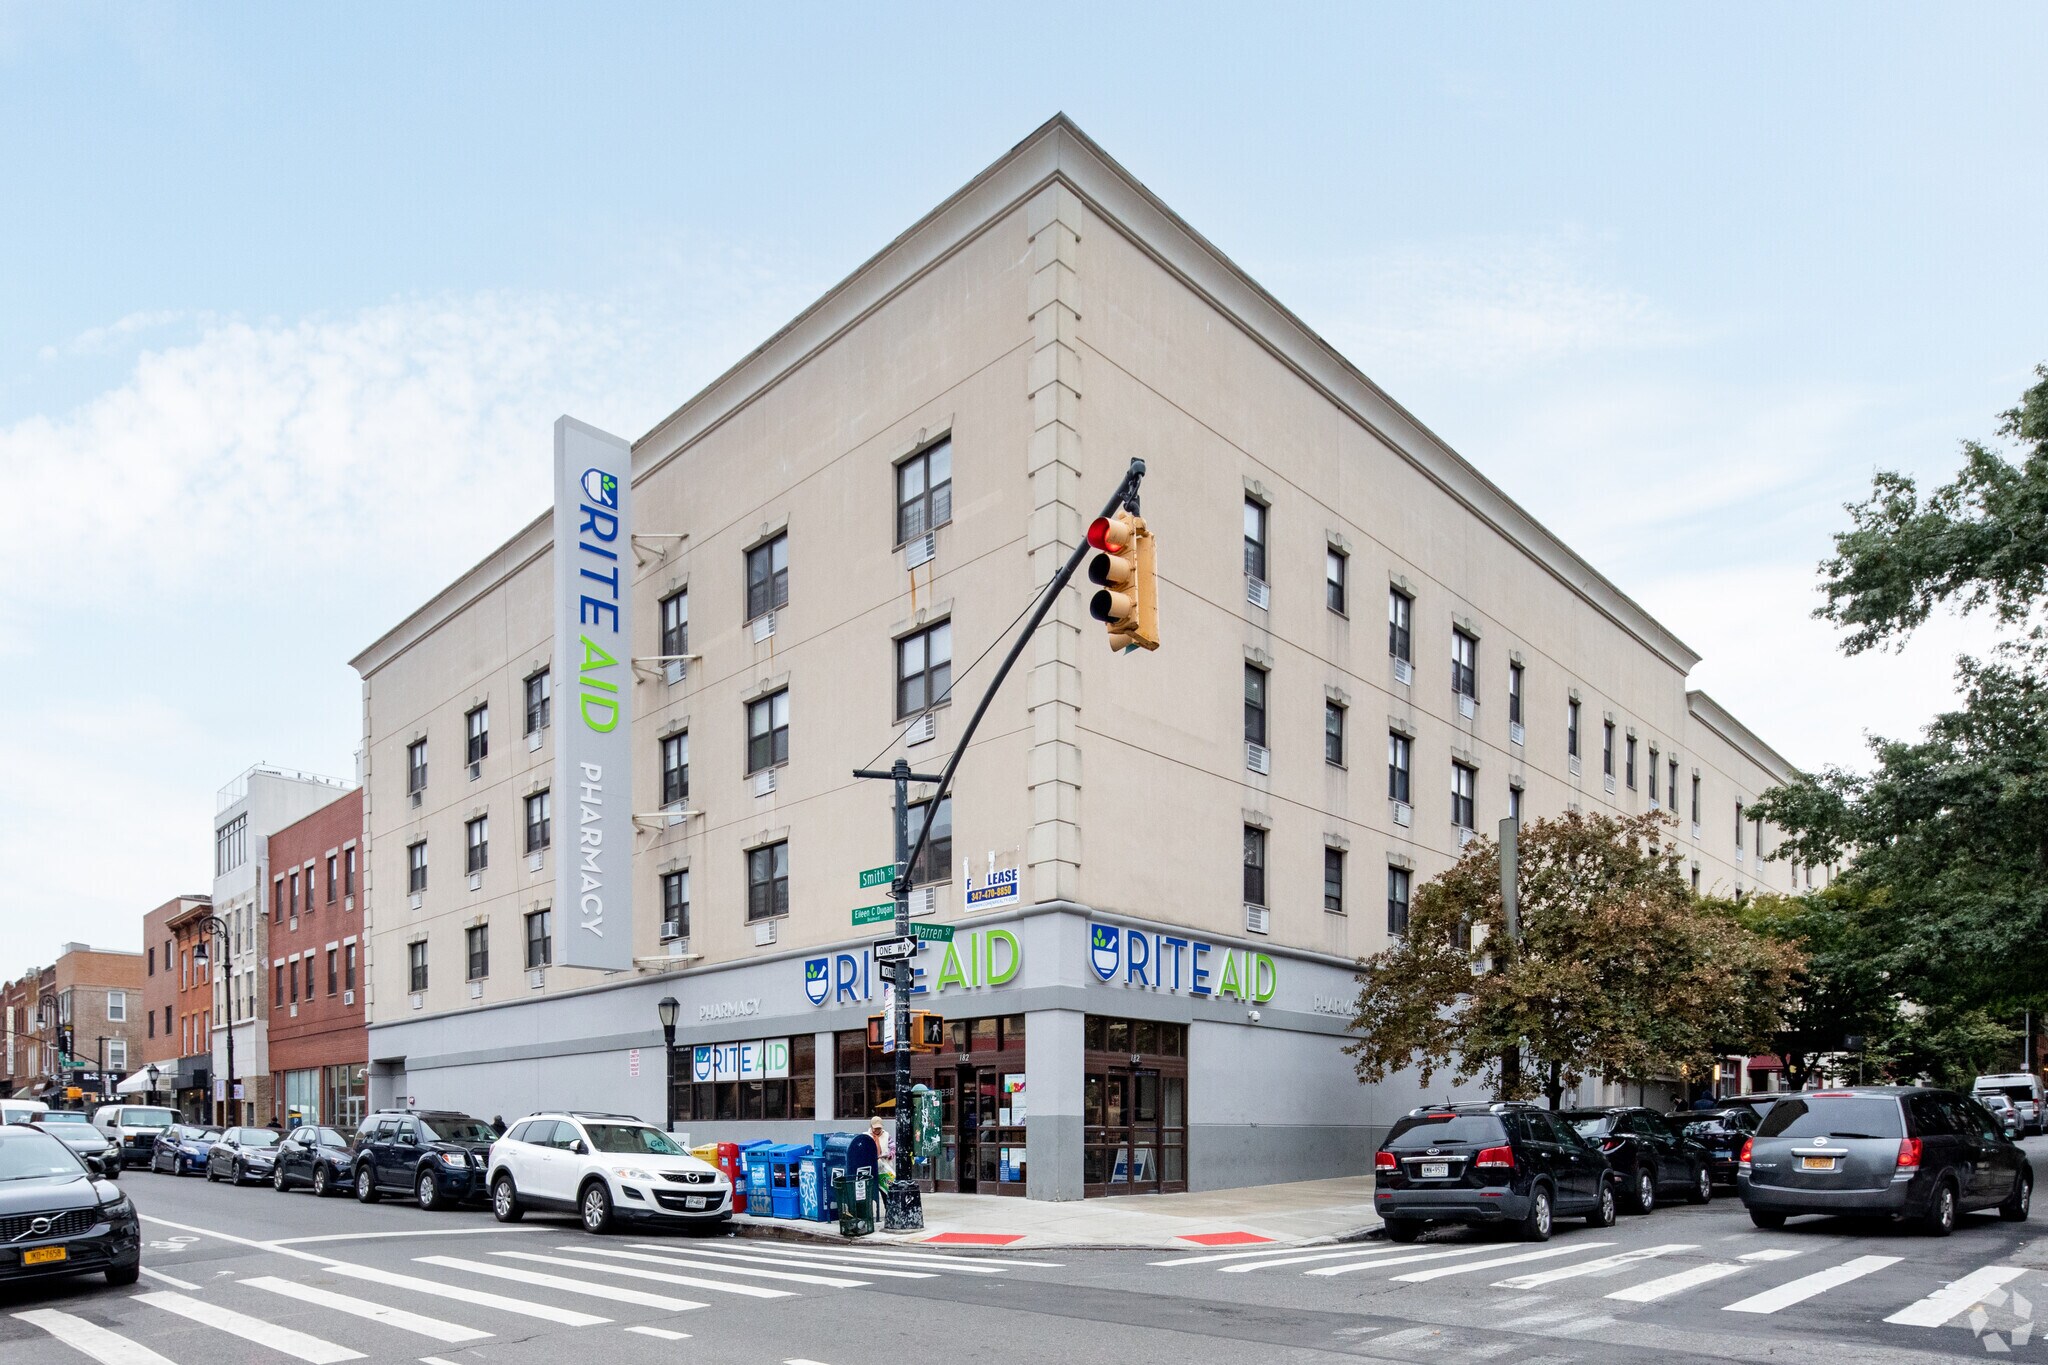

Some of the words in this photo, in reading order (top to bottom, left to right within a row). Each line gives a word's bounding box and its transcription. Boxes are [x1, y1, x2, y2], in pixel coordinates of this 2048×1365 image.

[579, 506, 619, 633] RITE
[580, 634, 619, 733] AID
[580, 761, 603, 938] PHARMACY
[862, 870, 885, 886] Smith
[887, 867, 894, 875] St
[988, 869, 1017, 886] LEASE
[971, 885, 1012, 901] 347-470-8850
[854, 909, 870, 919] Eileen
[871, 907, 875, 916] C
[876, 906, 893, 916] Dugan
[914, 925, 942, 940] Warren
[945, 928, 951, 936] St
[879, 945, 892, 955] ONE
[897, 943, 911, 953] WAY
[836, 942, 928, 1002] RIE
[937, 930, 1021, 991] AID
[884, 968, 895, 977] ONE
[1125, 930, 1212, 995] RITE
[1218, 948, 1277, 1002] AID
[700, 998, 762, 1021] PHARMACY
[1314, 993, 1360, 1014] PHARMA
[713, 1046, 752, 1073] RITE
[755, 1043, 789, 1072] AID
[959, 1053, 970, 1062] 182
[83, 1073, 118, 1081] BALS
